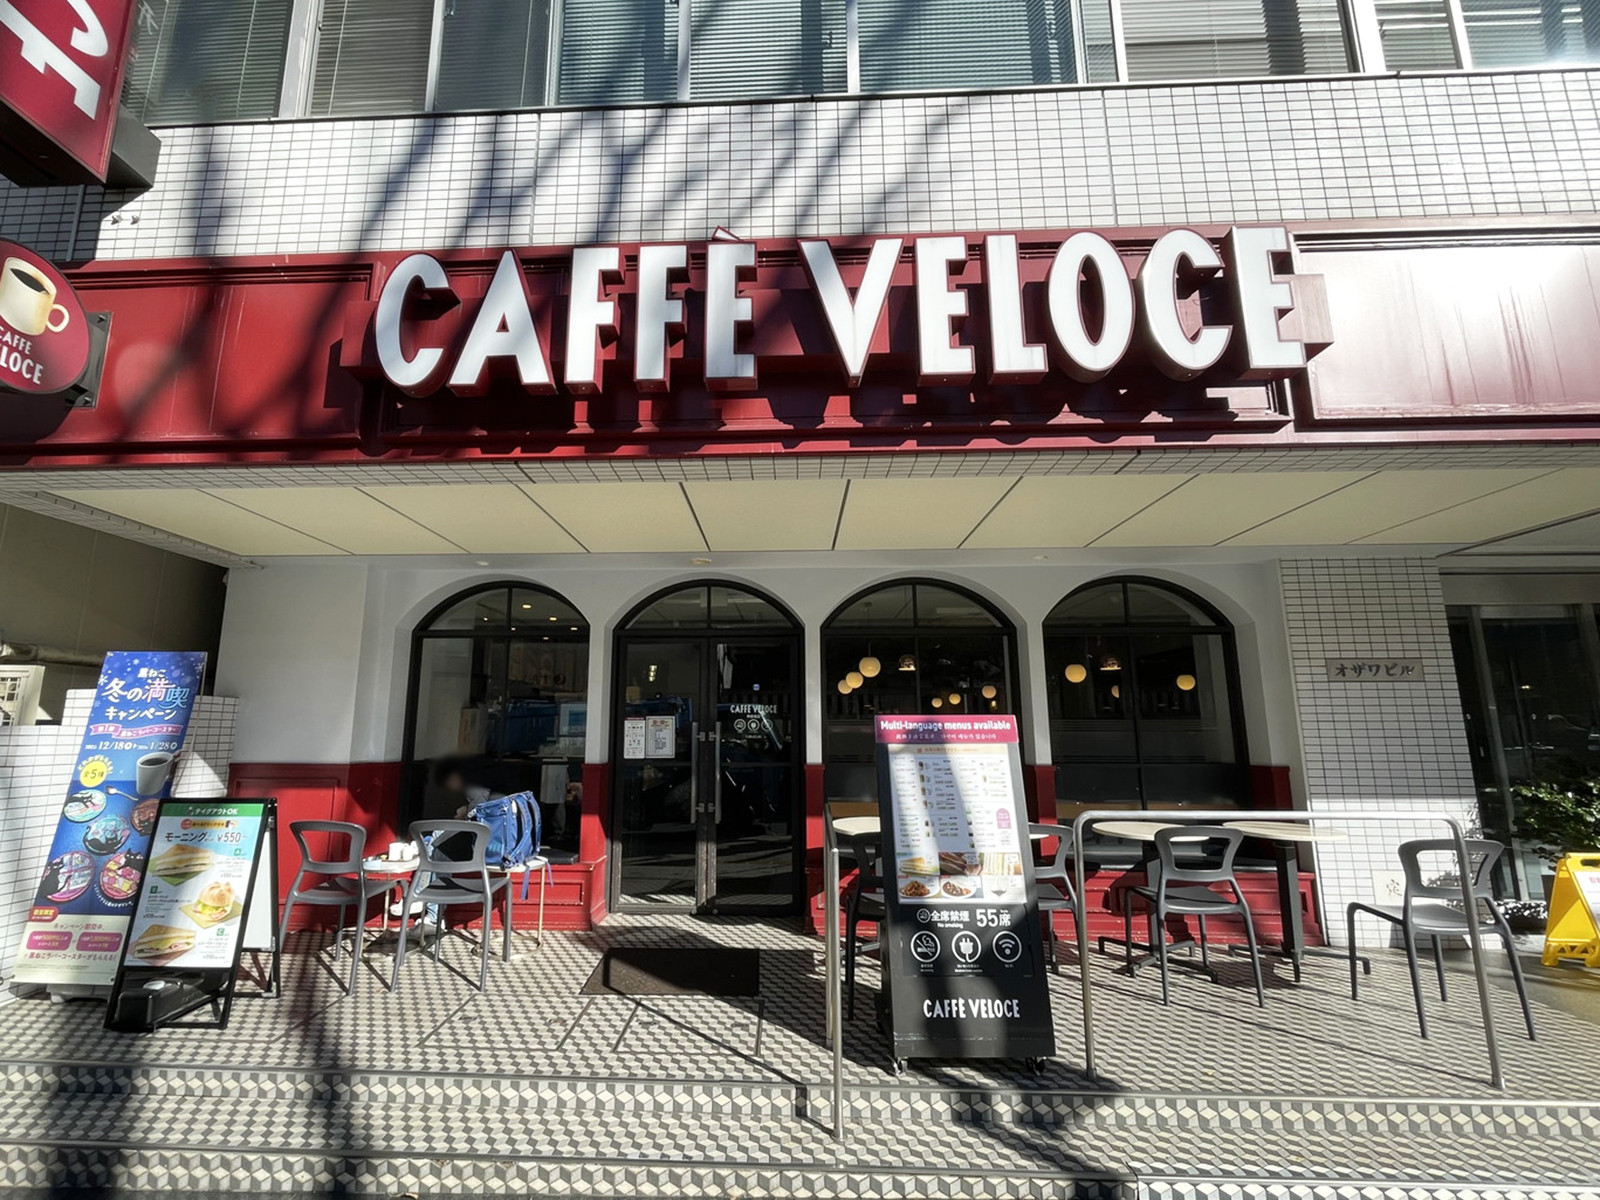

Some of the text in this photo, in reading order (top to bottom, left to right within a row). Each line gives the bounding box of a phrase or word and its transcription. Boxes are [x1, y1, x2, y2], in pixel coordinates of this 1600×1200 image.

[799, 225, 1307, 382] VELOCE
[0, 344, 43, 385] LOCE
[1335, 663, 1415, 678] オザワビル
[101, 677, 190, 709] 冬の満喫
[105, 706, 177, 721] キャンペーン
[880, 720, 1011, 731] Multi-language menus available
[165, 831, 208, 843] モーニング
[931, 910, 970, 922] 全席禁煙
[968, 998, 1021, 1019] VELOCE
